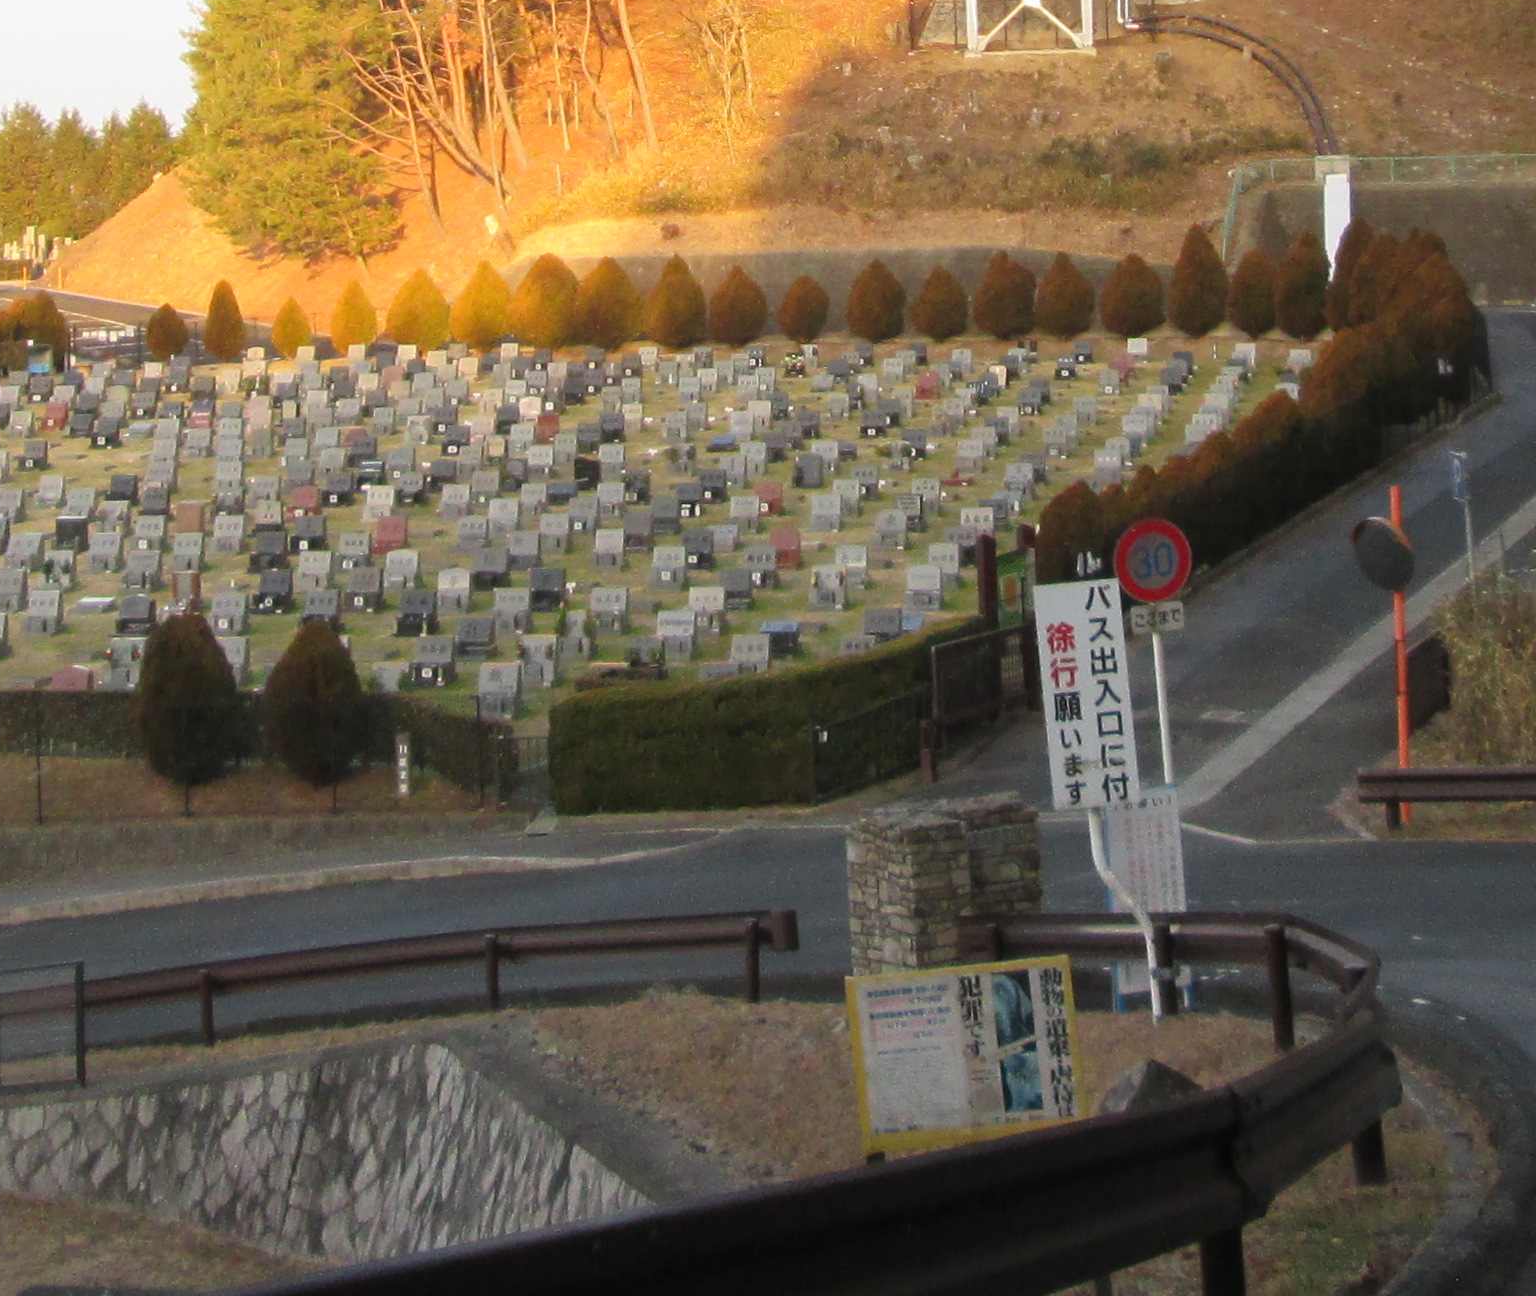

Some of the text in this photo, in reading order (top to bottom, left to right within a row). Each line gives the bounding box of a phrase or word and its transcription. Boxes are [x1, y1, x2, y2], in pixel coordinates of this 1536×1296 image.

[1134, 542, 1174, 580] 30
[1135, 608, 1181, 628] ここまで
[1046, 622, 1087, 806] 徐行願います
[1085, 585, 1131, 804] バス出入口に付
